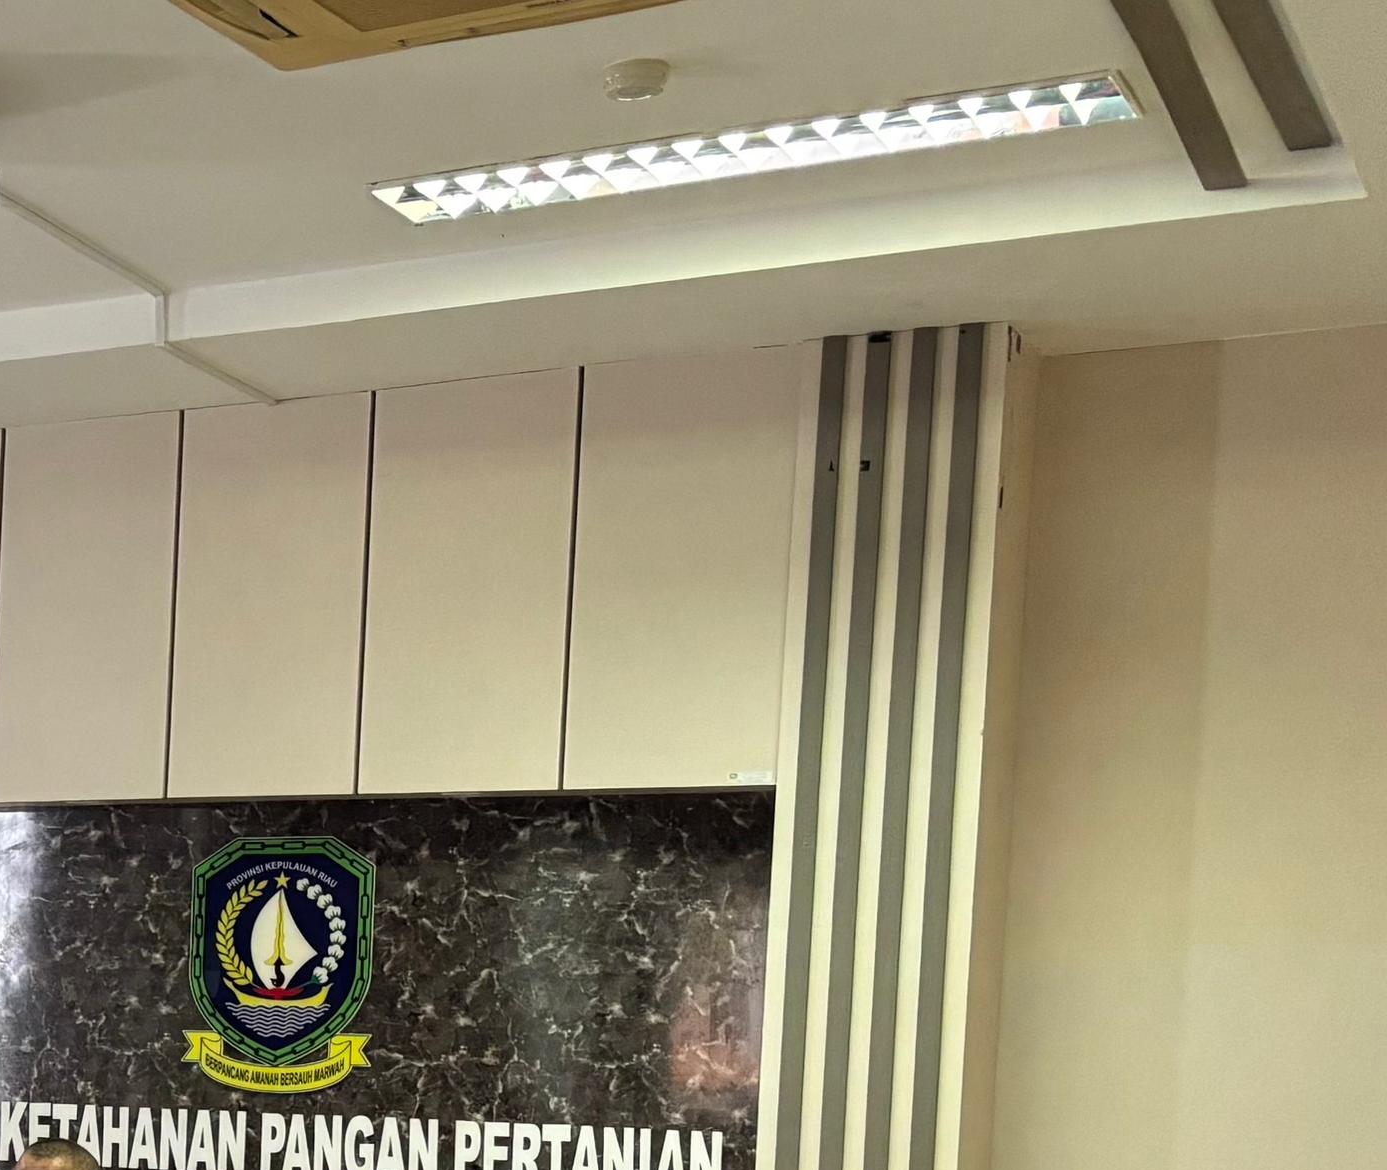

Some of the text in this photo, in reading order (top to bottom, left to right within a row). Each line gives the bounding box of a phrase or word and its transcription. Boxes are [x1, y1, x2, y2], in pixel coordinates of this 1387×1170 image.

[227, 861, 338, 890] PROVINSI KEPULAUAN RIAU
[205, 1053, 345, 1087] BERPANCANG AMANAH BERSAUH MARWAH
